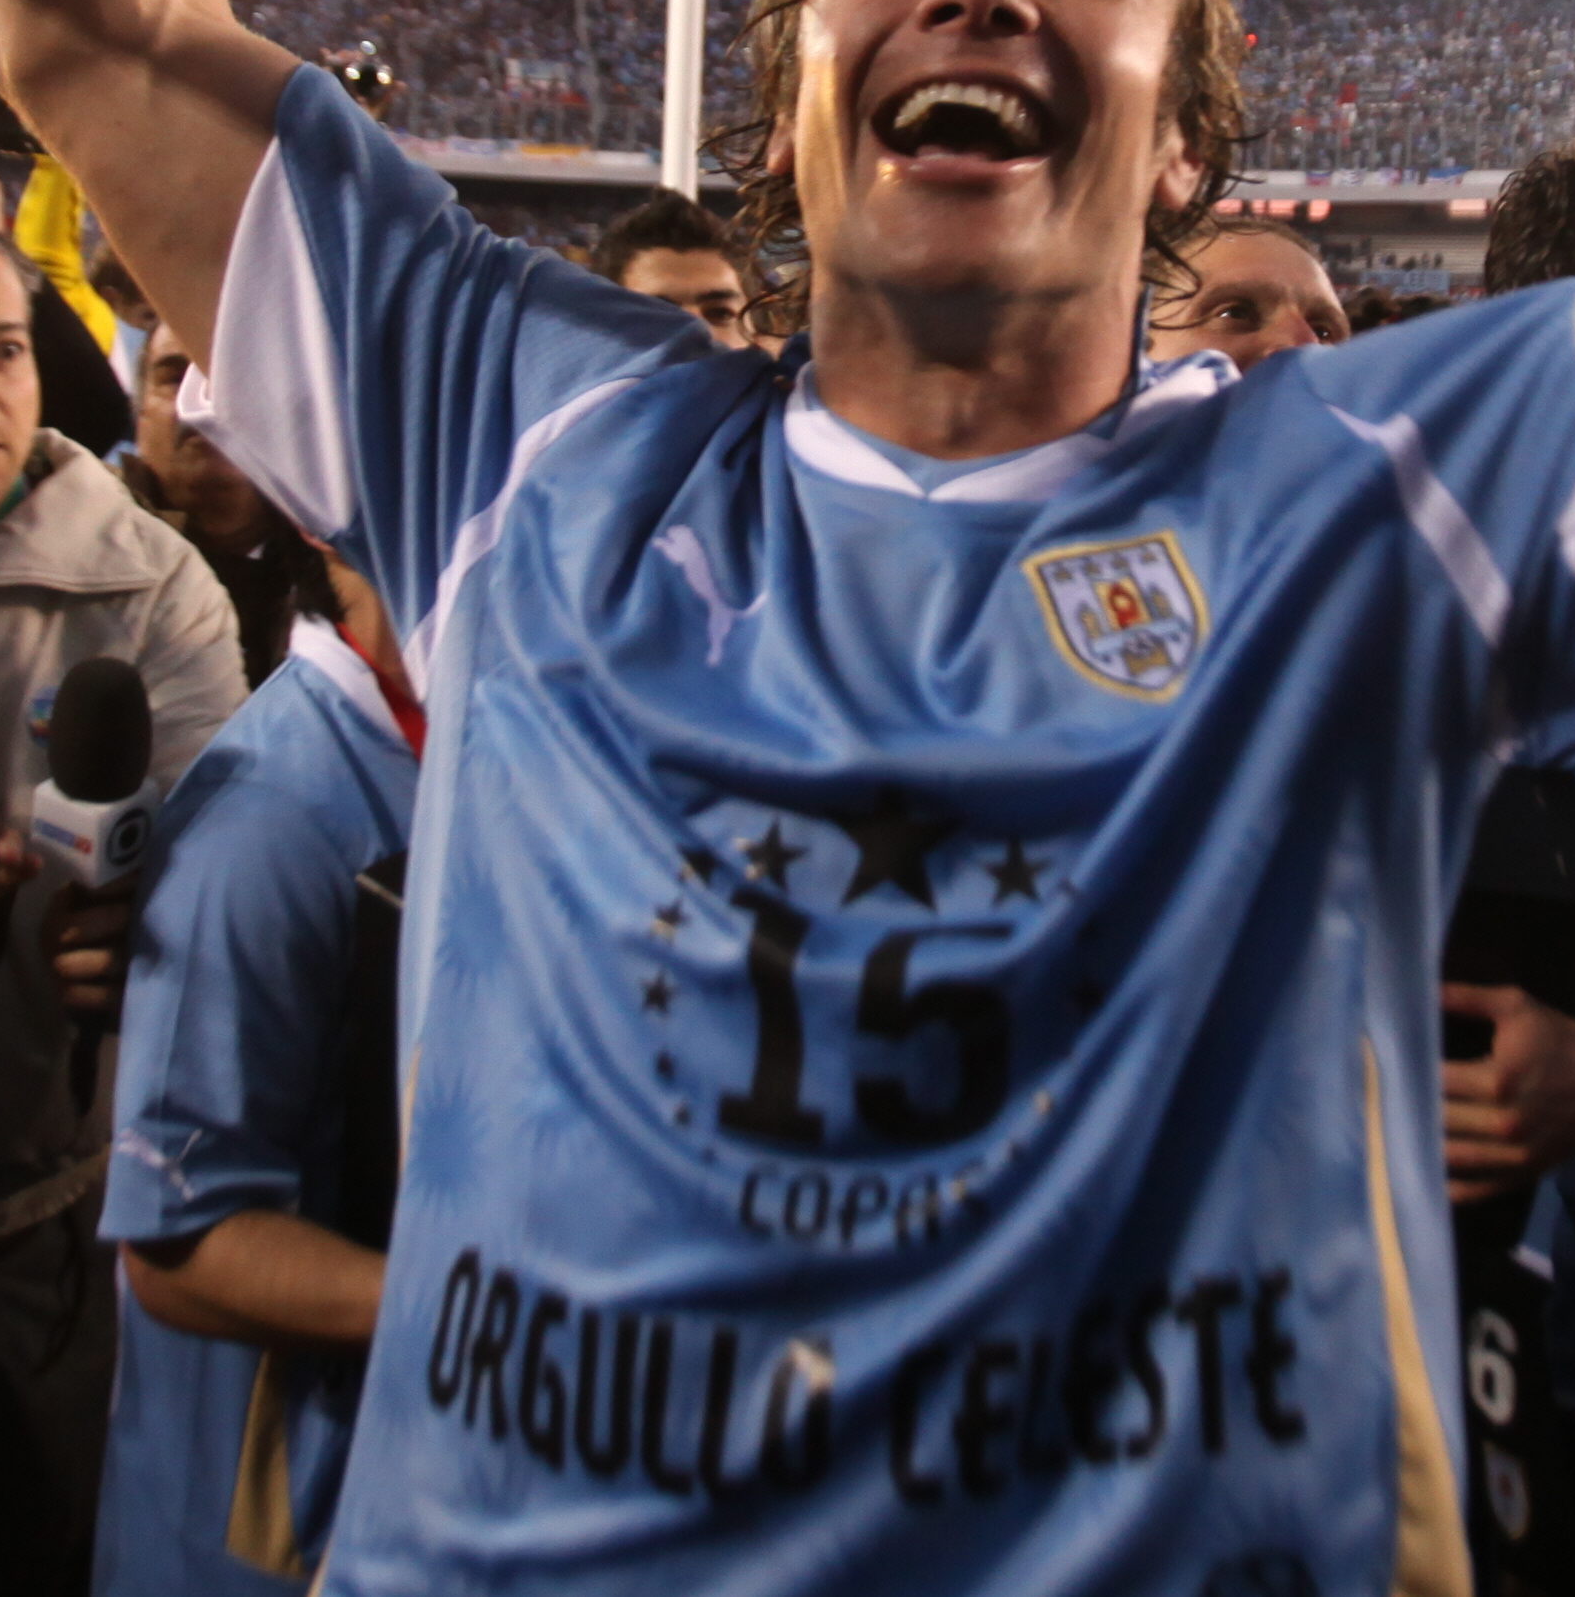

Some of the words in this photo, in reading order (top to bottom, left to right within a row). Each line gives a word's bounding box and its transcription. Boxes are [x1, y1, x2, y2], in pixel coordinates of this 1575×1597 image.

[719, 885, 1016, 1148] 15
[428, 1245, 834, 1500] ORGULLO
[889, 1267, 1306, 1508] CELESTE
